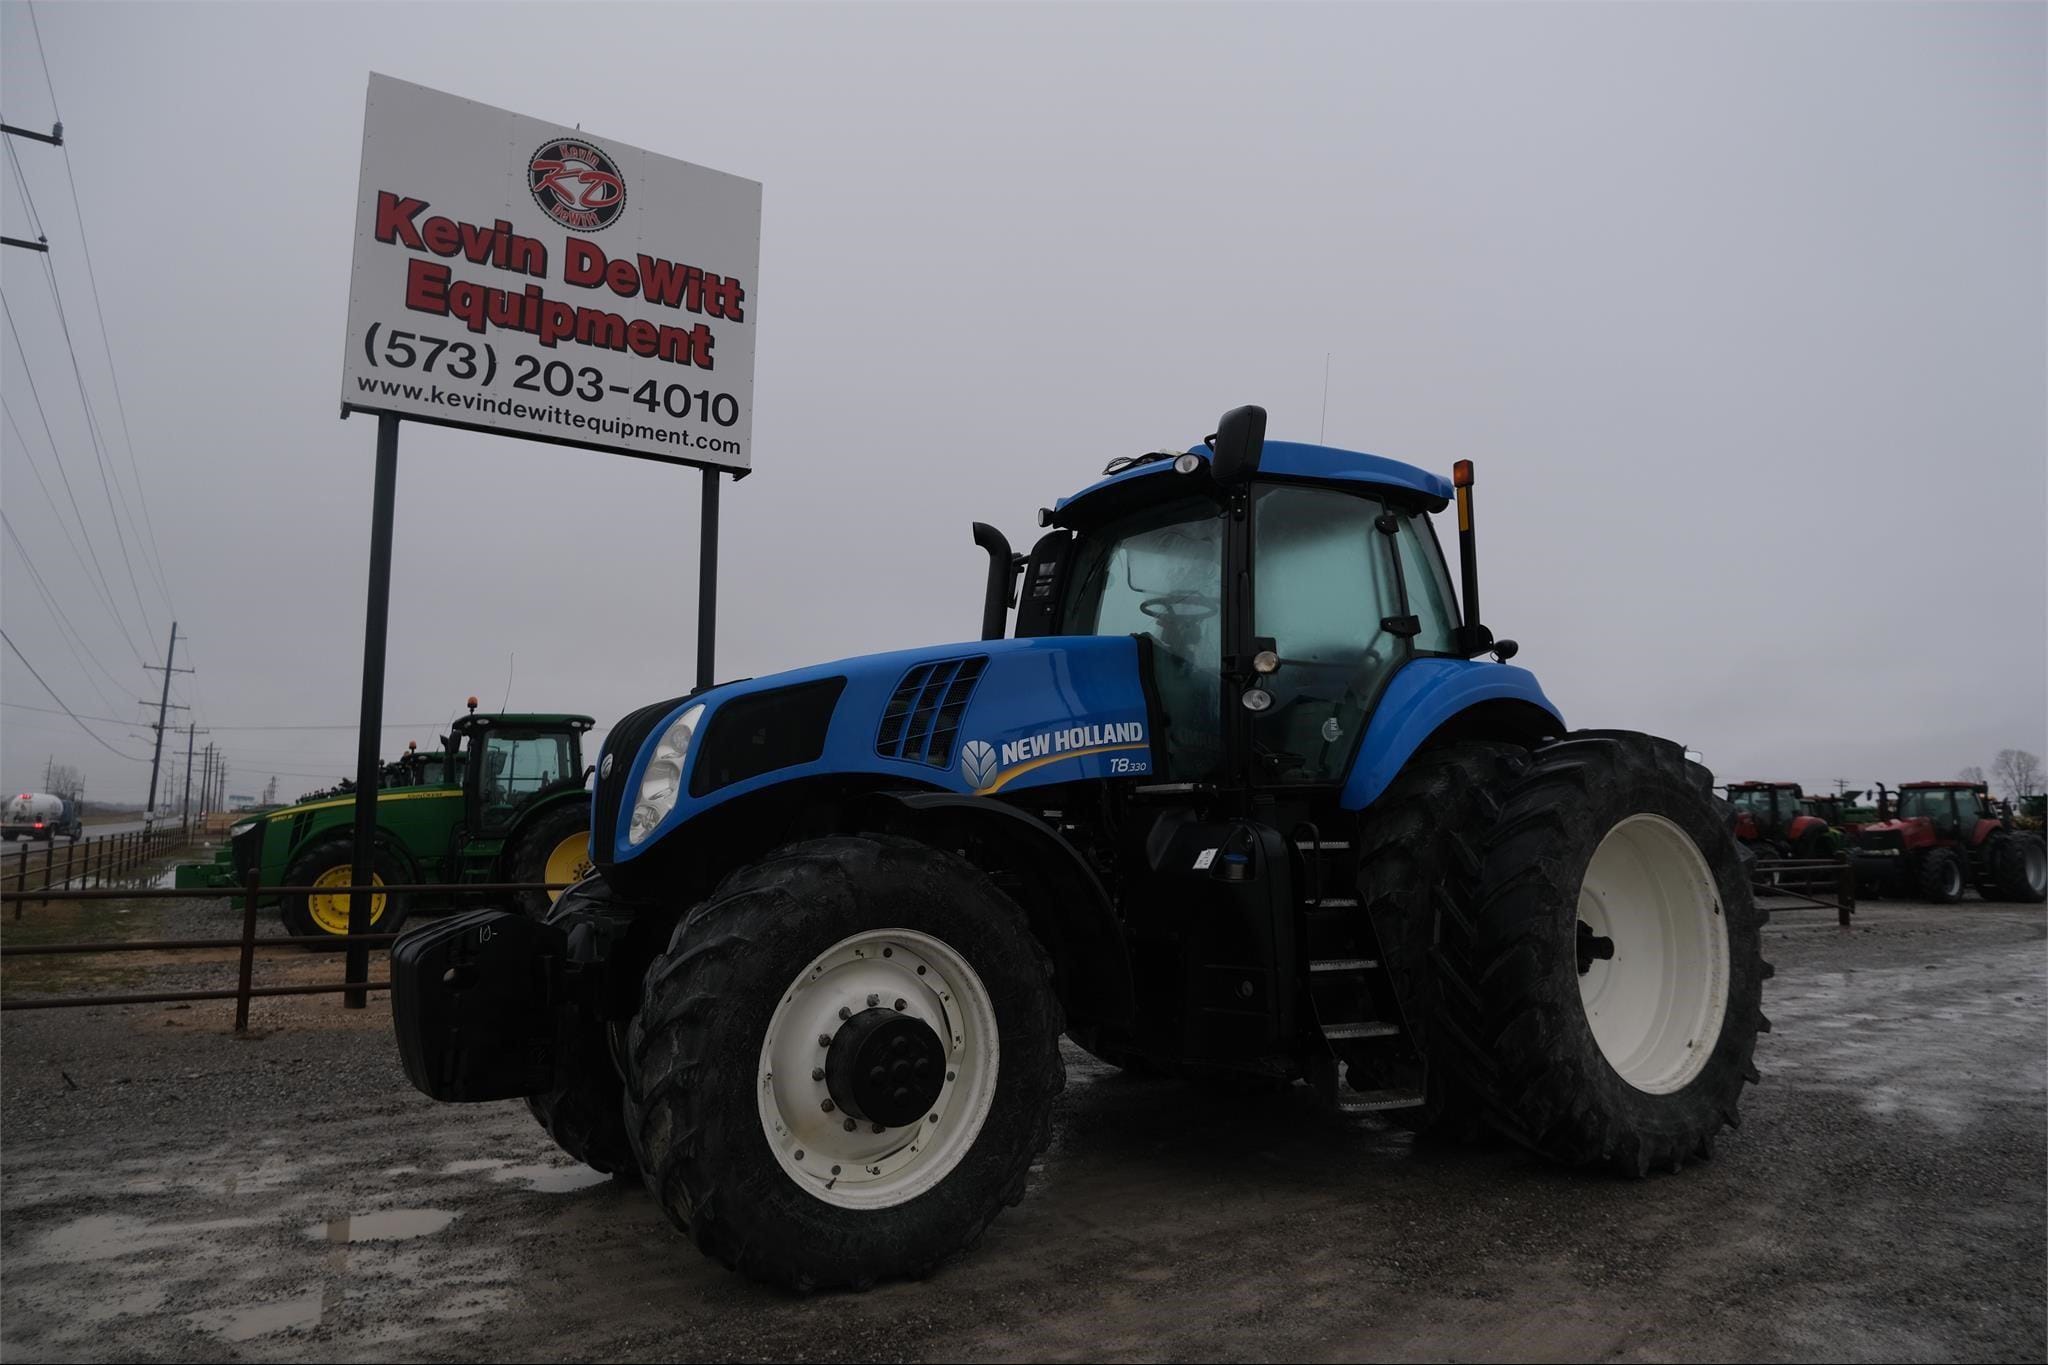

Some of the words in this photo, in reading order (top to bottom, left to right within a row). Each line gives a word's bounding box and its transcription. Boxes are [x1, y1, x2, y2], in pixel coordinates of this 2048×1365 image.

[558, 144, 601, 168] Kevin
[375, 190, 548, 279] Kevin
[564, 236, 745, 323] DeWitt
[405, 258, 716, 370] Equipment
[357, 375, 741, 455] www.kevindewittequipment.com
[365, 322, 497, 386] (573)
[513, 354, 739, 428] 203-4010
[1002, 732, 1050, 766] NEW
[1055, 721, 1143, 752] HOLLAND
[1110, 758, 1147, 774] T8.330
